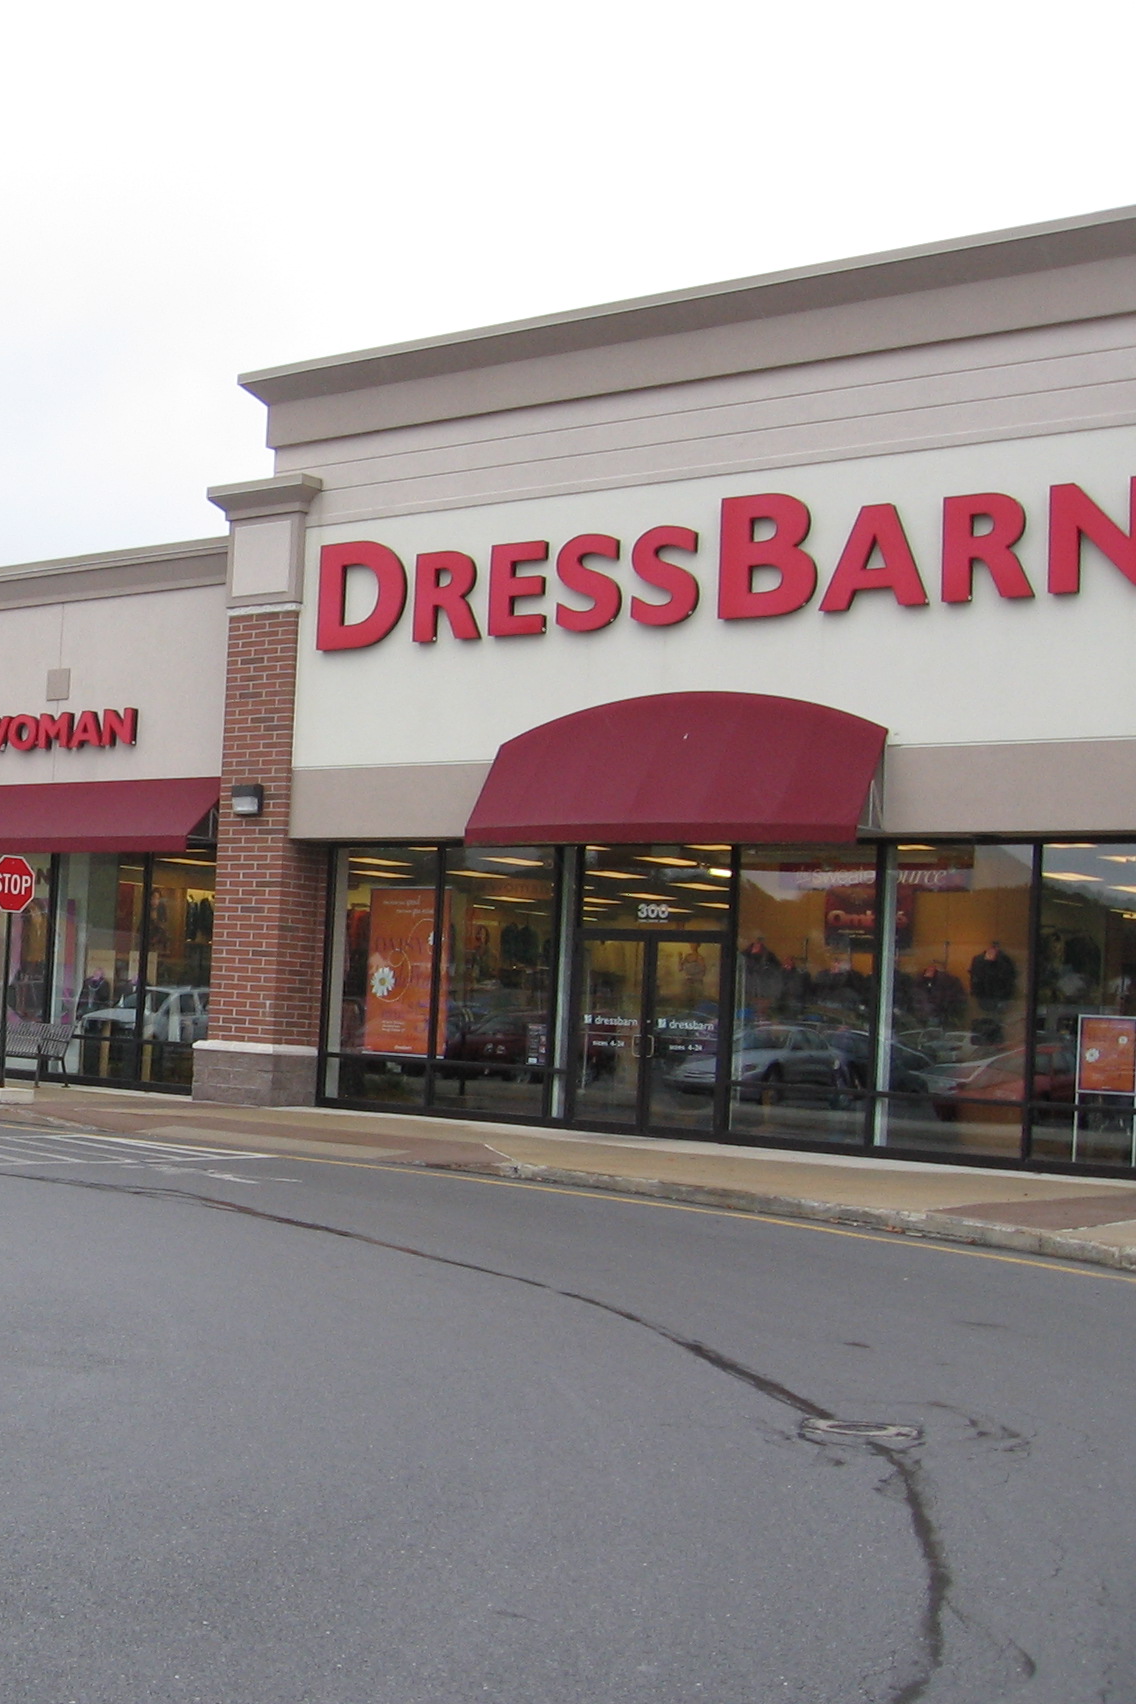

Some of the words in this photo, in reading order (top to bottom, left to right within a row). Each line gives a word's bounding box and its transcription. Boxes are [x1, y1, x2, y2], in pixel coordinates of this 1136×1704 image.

[637, 902, 669, 918] 300
[595, 1015, 639, 1027] dressbarn
[669, 1020, 715, 1032] dressbarn
